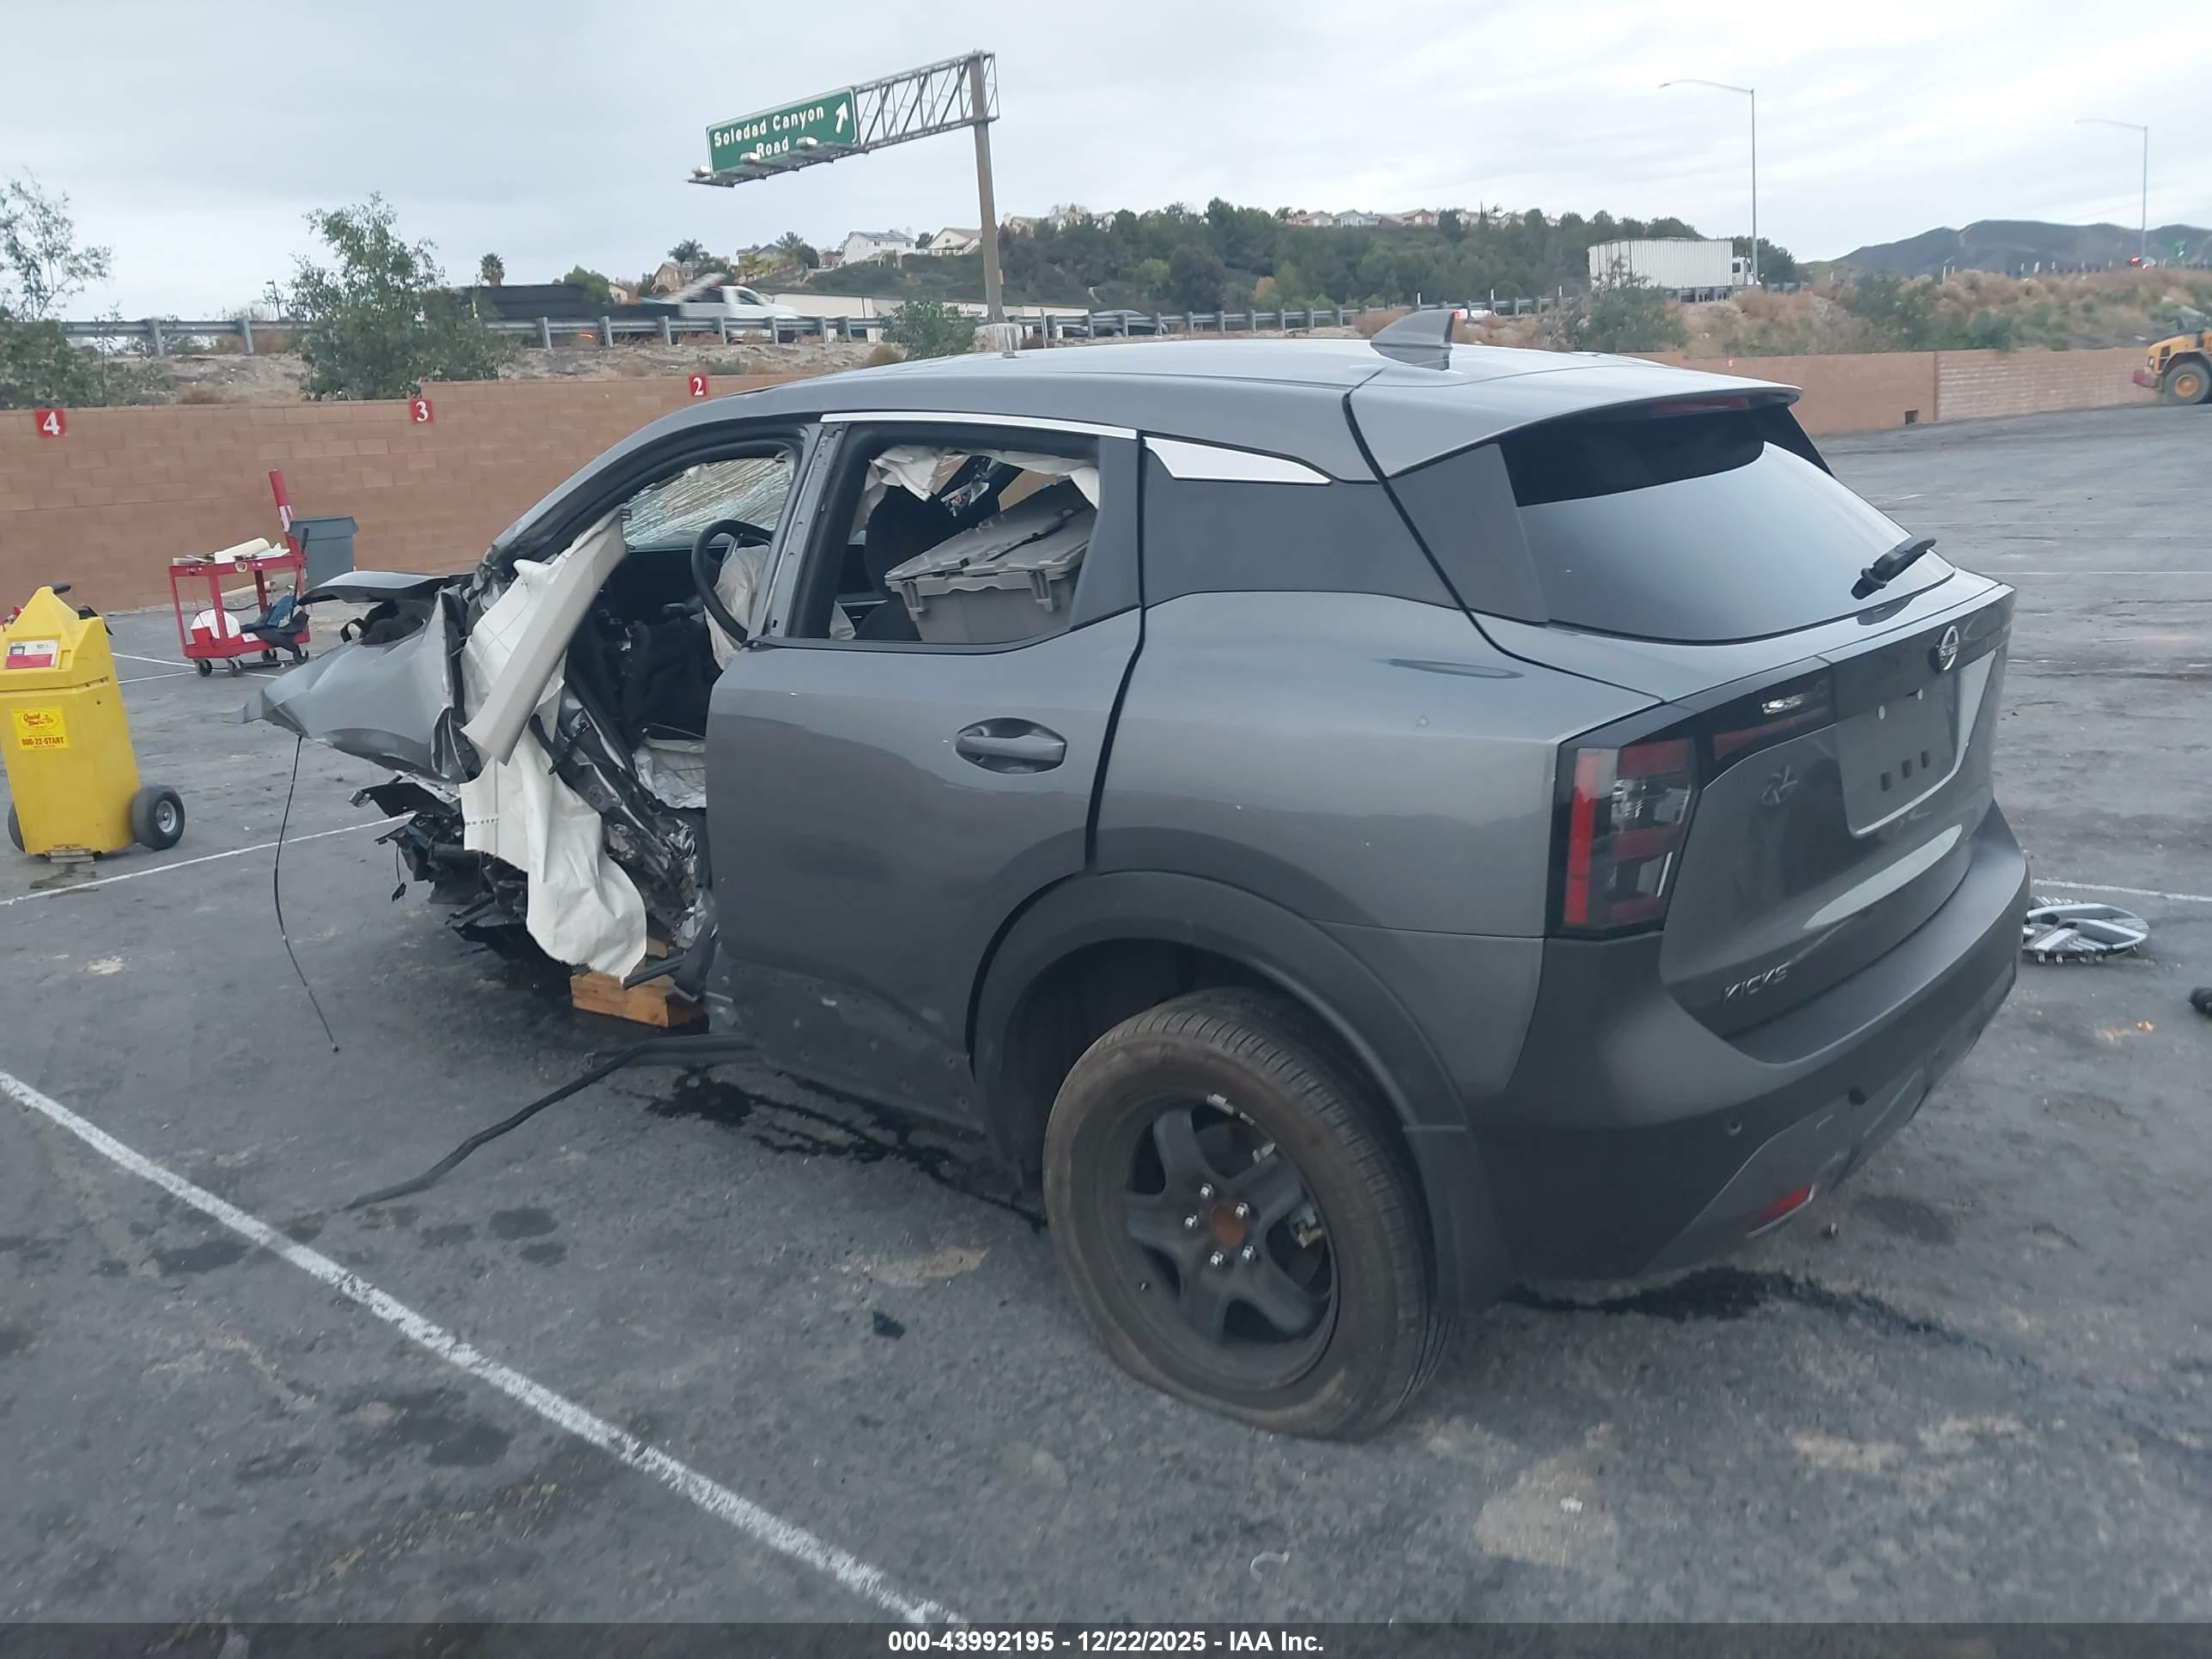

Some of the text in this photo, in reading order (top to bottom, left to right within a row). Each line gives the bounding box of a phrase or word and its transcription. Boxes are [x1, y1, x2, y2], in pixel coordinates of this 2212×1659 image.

[714, 106, 824, 148] Soledad Canyon
[755, 136, 789, 158] Road
[693, 376, 704, 396] 2
[416, 400, 429, 422] 3
[43, 411, 61, 435] 4
